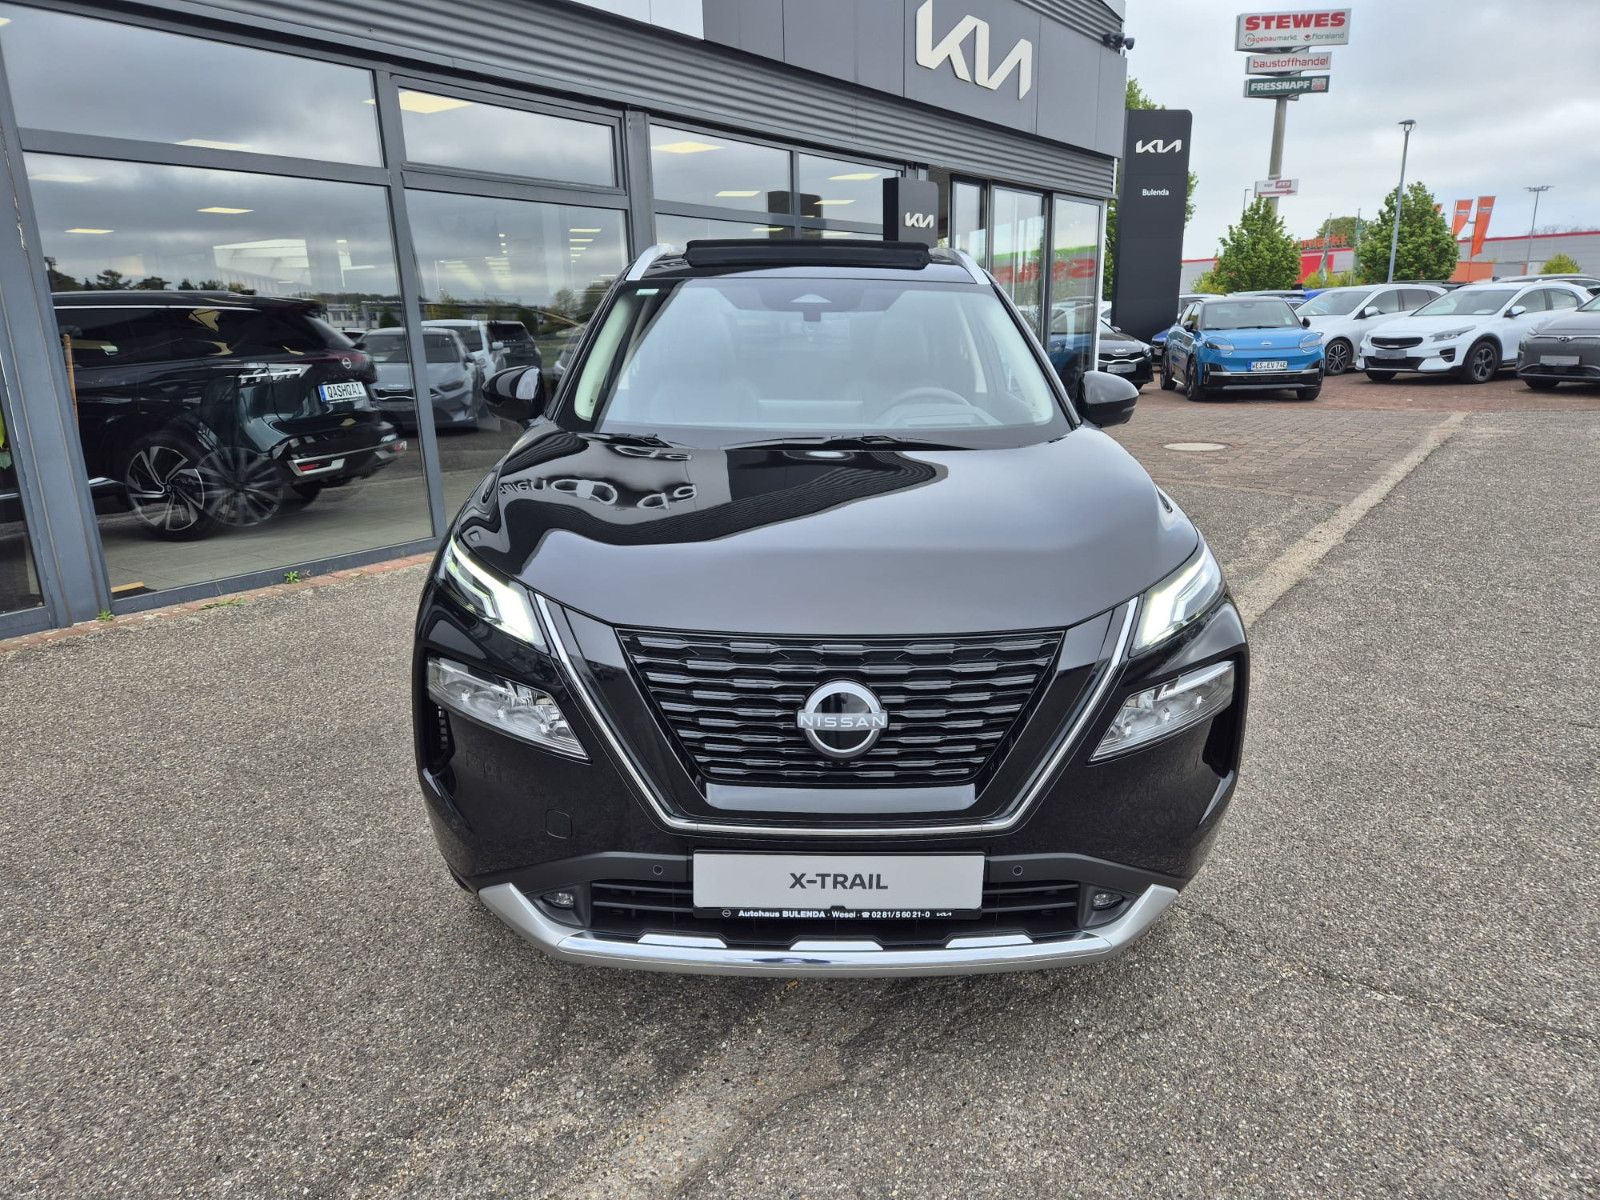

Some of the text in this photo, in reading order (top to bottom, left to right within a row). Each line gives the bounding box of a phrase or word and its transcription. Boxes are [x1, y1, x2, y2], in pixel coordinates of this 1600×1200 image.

[1245, 12, 1346, 31] STEWES
[1247, 35, 1297, 44] hagebaumarkt
[1252, 56, 1329, 68] baustoffhandel
[1250, 80, 1310, 91] FRESSNAPF
[1141, 188, 1170, 197] Bulenda
[327, 383, 363, 398] QASHQAI
[800, 715, 886, 728] NISSAN
[789, 873, 889, 891] X-TRAIL
[738, 910, 780, 918] Autohaus
